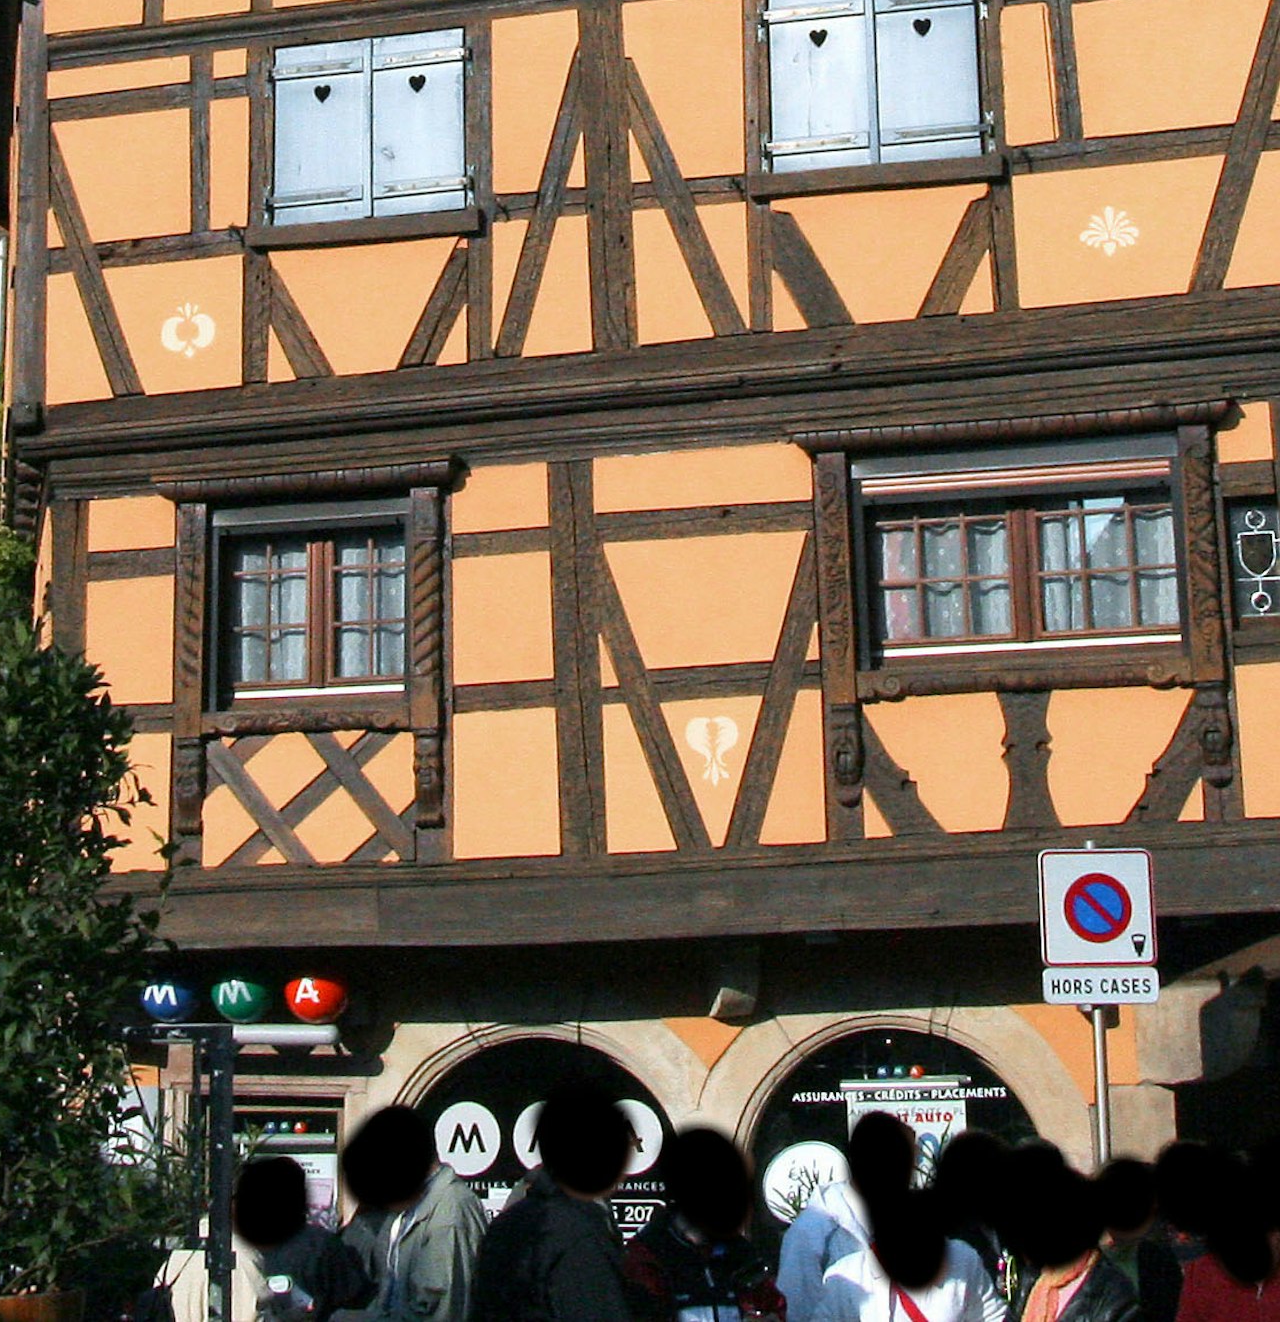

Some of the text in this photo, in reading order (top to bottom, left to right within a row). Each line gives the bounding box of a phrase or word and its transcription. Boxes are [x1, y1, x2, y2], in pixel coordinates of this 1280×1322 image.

[1051, 978, 1151, 995] HORS CASES
[792, 1090, 865, 1102] ASSURANCES
[874, 1087, 921, 1101] CRÉDITS
[931, 1086, 1007, 1100] PLACEMENTS
[914, 1111, 954, 1123] AUTO
[447, 1122, 487, 1154] M
[612, 1181, 666, 1192] RANCES
[624, 1205, 655, 1223] 207
